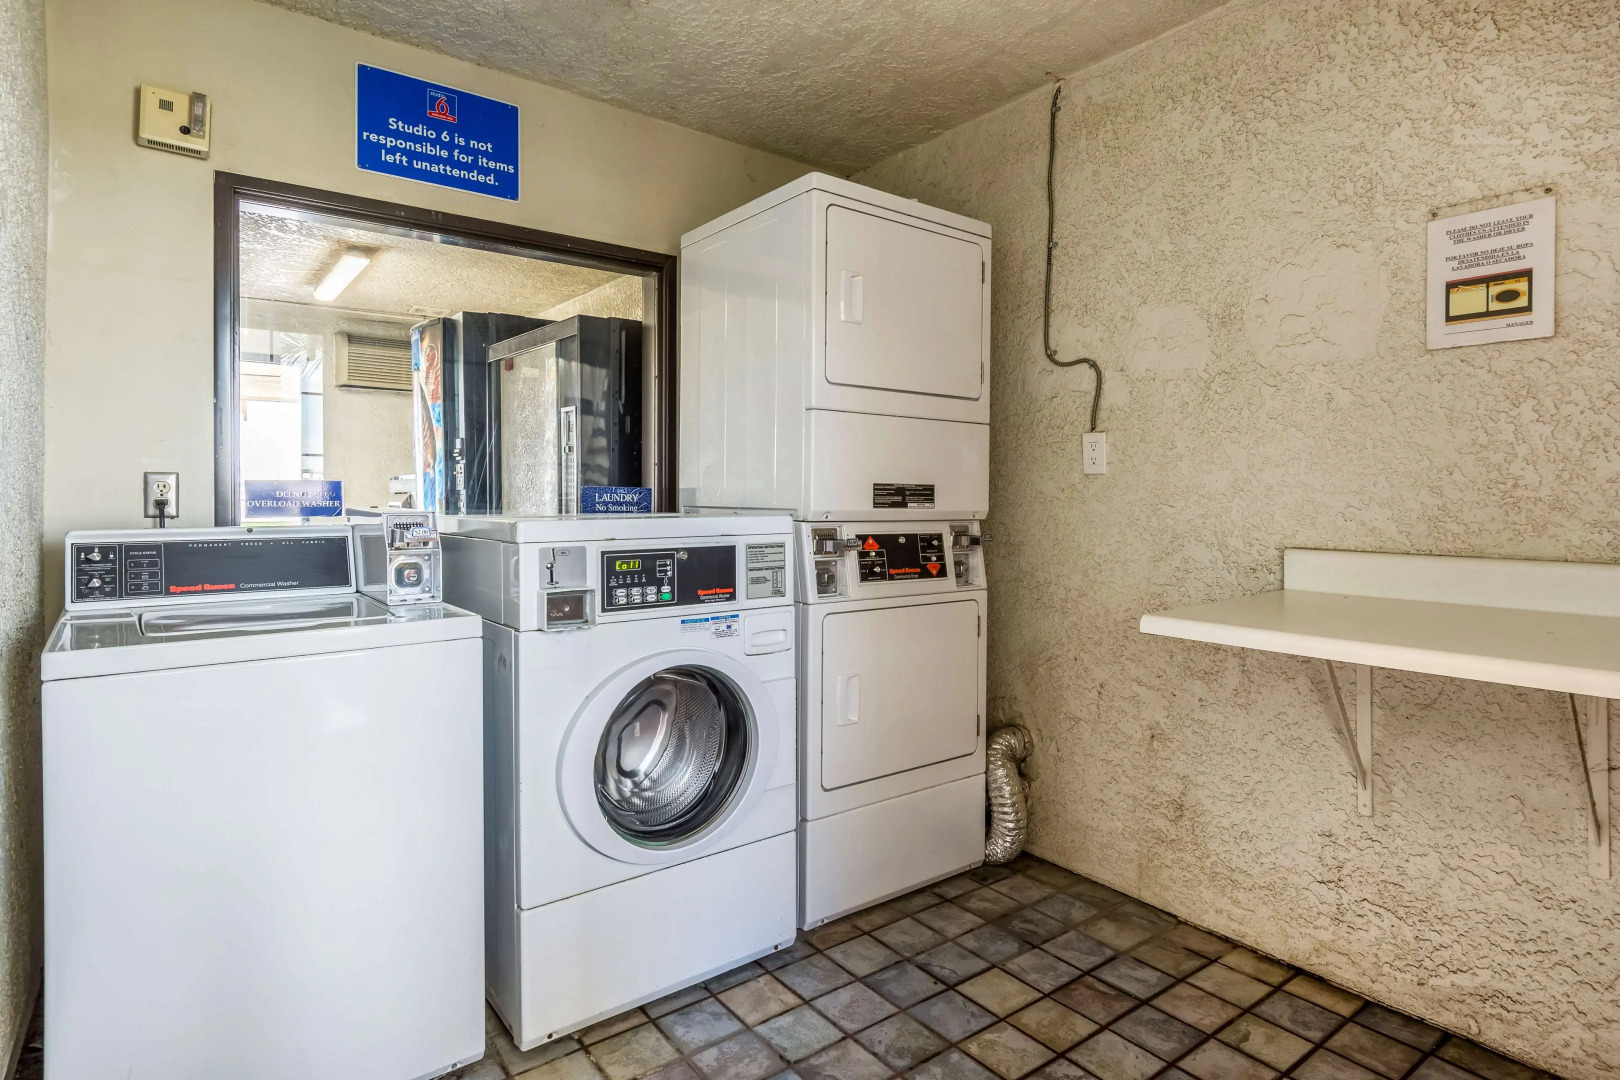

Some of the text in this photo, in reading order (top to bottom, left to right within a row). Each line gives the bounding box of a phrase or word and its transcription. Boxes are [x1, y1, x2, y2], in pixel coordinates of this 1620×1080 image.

[388, 118, 492, 152] Studio 6 is not
[363, 131, 514, 173] responsible for items
[382, 150, 499, 185] left unattended.
[1446, 227, 1467, 235] PLEASE
[1493, 218, 1513, 226] LEAVE
[1449, 231, 1476, 240] CLOTHES
[1466, 233, 1492, 242] WASHER
[1504, 227, 1525, 235] DRYER
[1452, 262, 1485, 271] LAVADORA
[596, 493, 638, 502] LAUNDRY
[608, 504, 638, 513] Smoking
[169, 584, 202, 593] Speed
